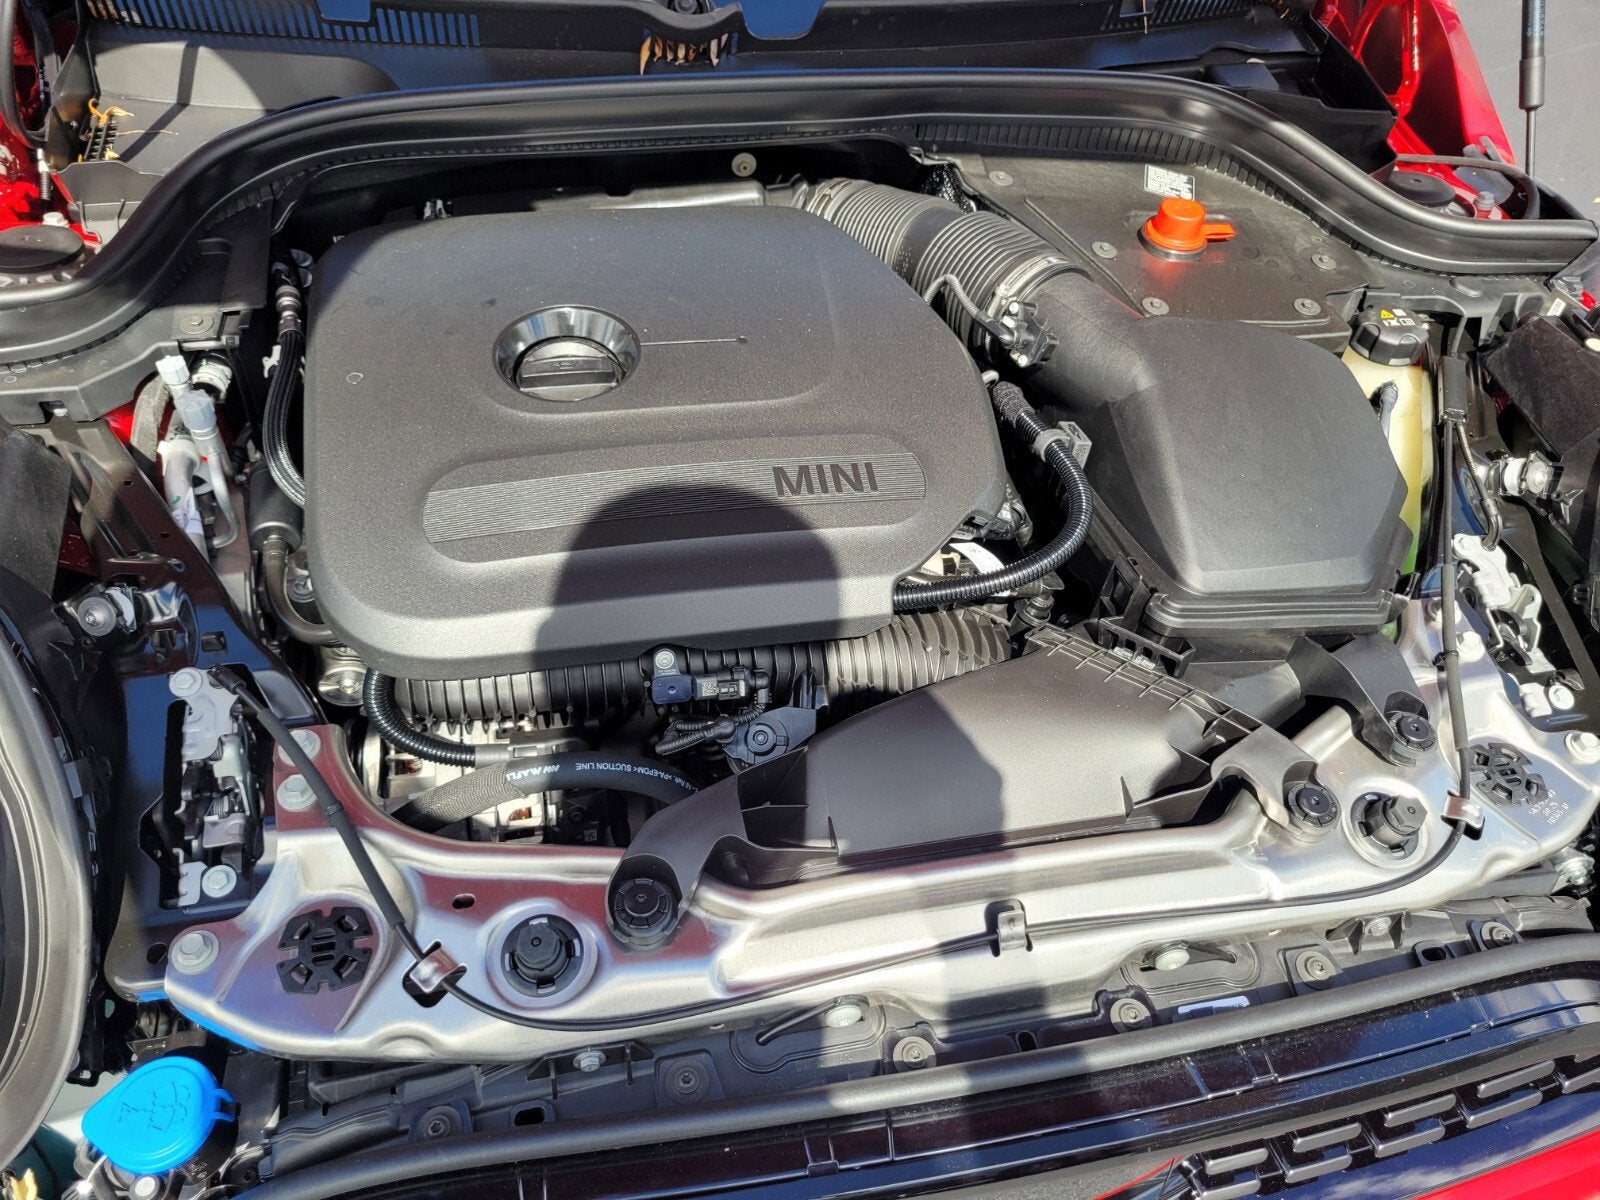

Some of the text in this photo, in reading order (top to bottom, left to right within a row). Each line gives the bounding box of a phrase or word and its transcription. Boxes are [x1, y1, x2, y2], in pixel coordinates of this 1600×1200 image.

[772, 462, 879, 496] MINI
[574, 762, 595, 771] LINE
[596, 763, 632, 772] SUCTION
